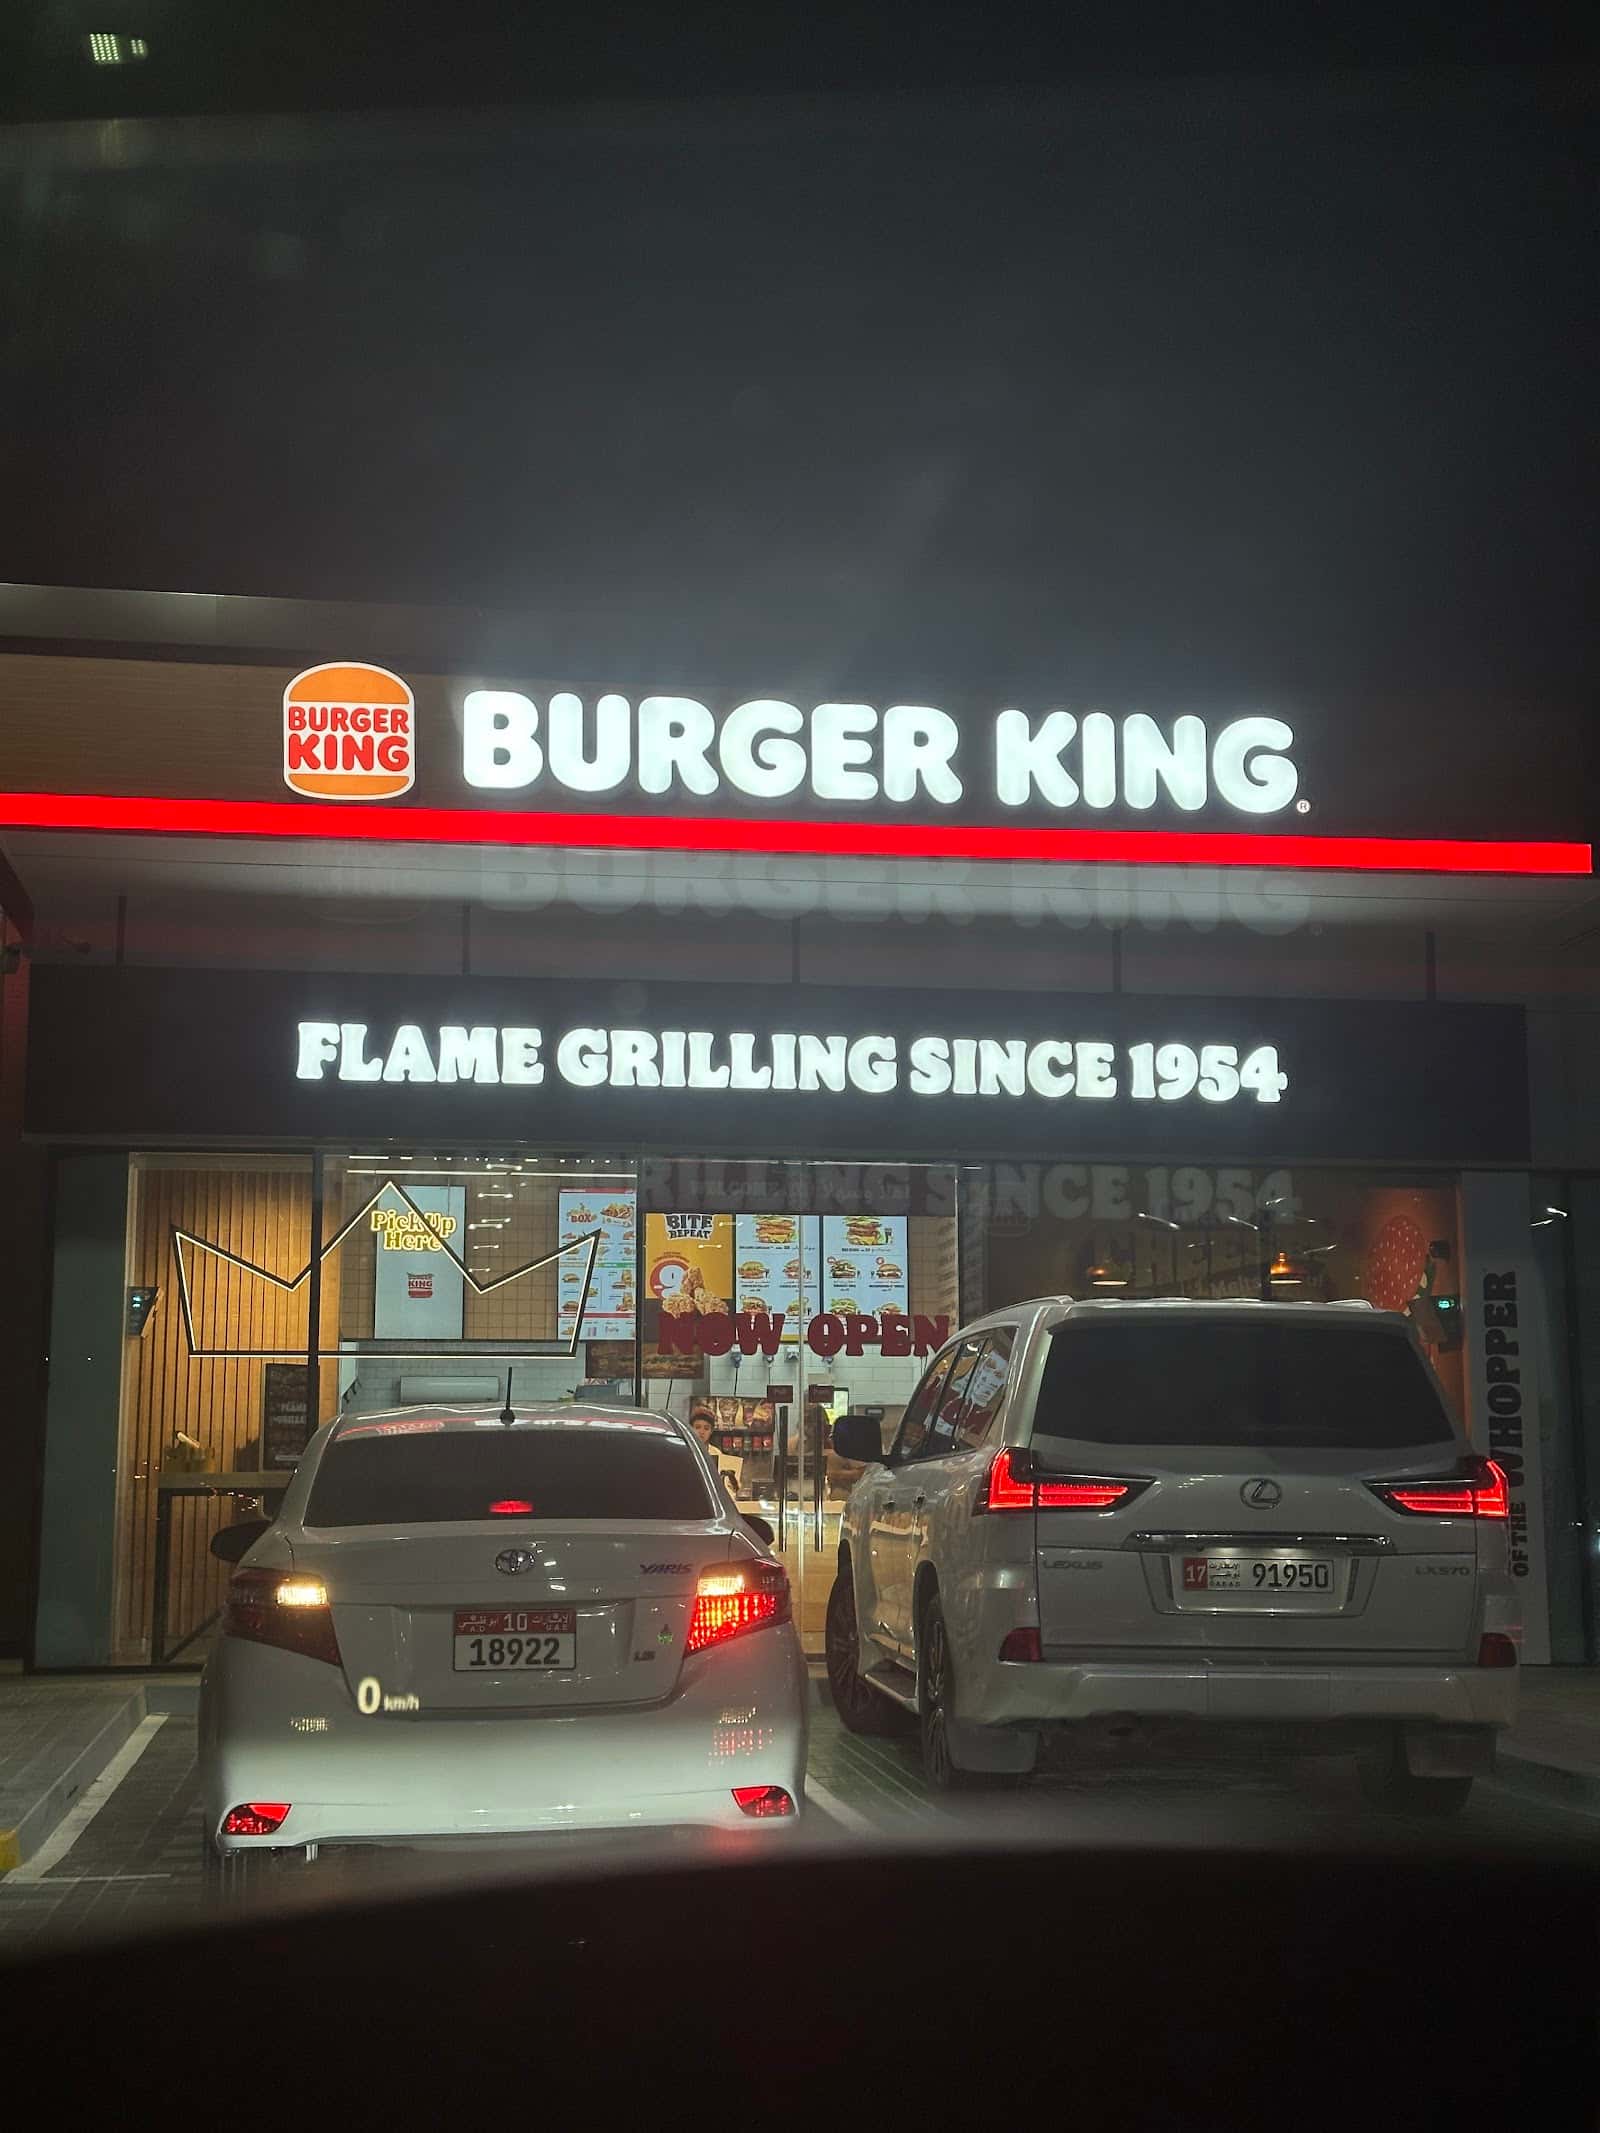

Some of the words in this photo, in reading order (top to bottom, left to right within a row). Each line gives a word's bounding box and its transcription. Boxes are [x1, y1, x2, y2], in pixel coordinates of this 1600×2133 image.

[288, 706, 409, 733] BURGER
[288, 733, 410, 772] KING
[463, 690, 963, 804] BURGER
[996, 709, 1299, 814] KING
[296, 1021, 545, 1084] FLAME
[557, 1028, 898, 1093] GRILLING
[910, 1036, 1118, 1098] SINCE
[1128, 1043, 1289, 1103] 1954
[664, 1214, 713, 1230] BITE
[668, 1229, 711, 1239] REPEAT
[383, 1229, 442, 1251] Here
[658, 1312, 785, 1356] NOW
[807, 1312, 950, 1357] OPEN
[1483, 1270, 1525, 1488] WHOPPER
[1510, 1502, 1529, 1545] THE
[639, 1563, 693, 1575] YARIS
[1042, 1560, 1104, 1570] LEXUS
[1186, 1564, 1207, 1583] 17
[1252, 1562, 1329, 1588] 91950
[1511, 1551, 1529, 1577] OF
[503, 1613, 528, 1631] 10
[469, 1638, 560, 1666] 18922
[358, 1676, 381, 1714] 0
[384, 1693, 420, 1712] km/h
